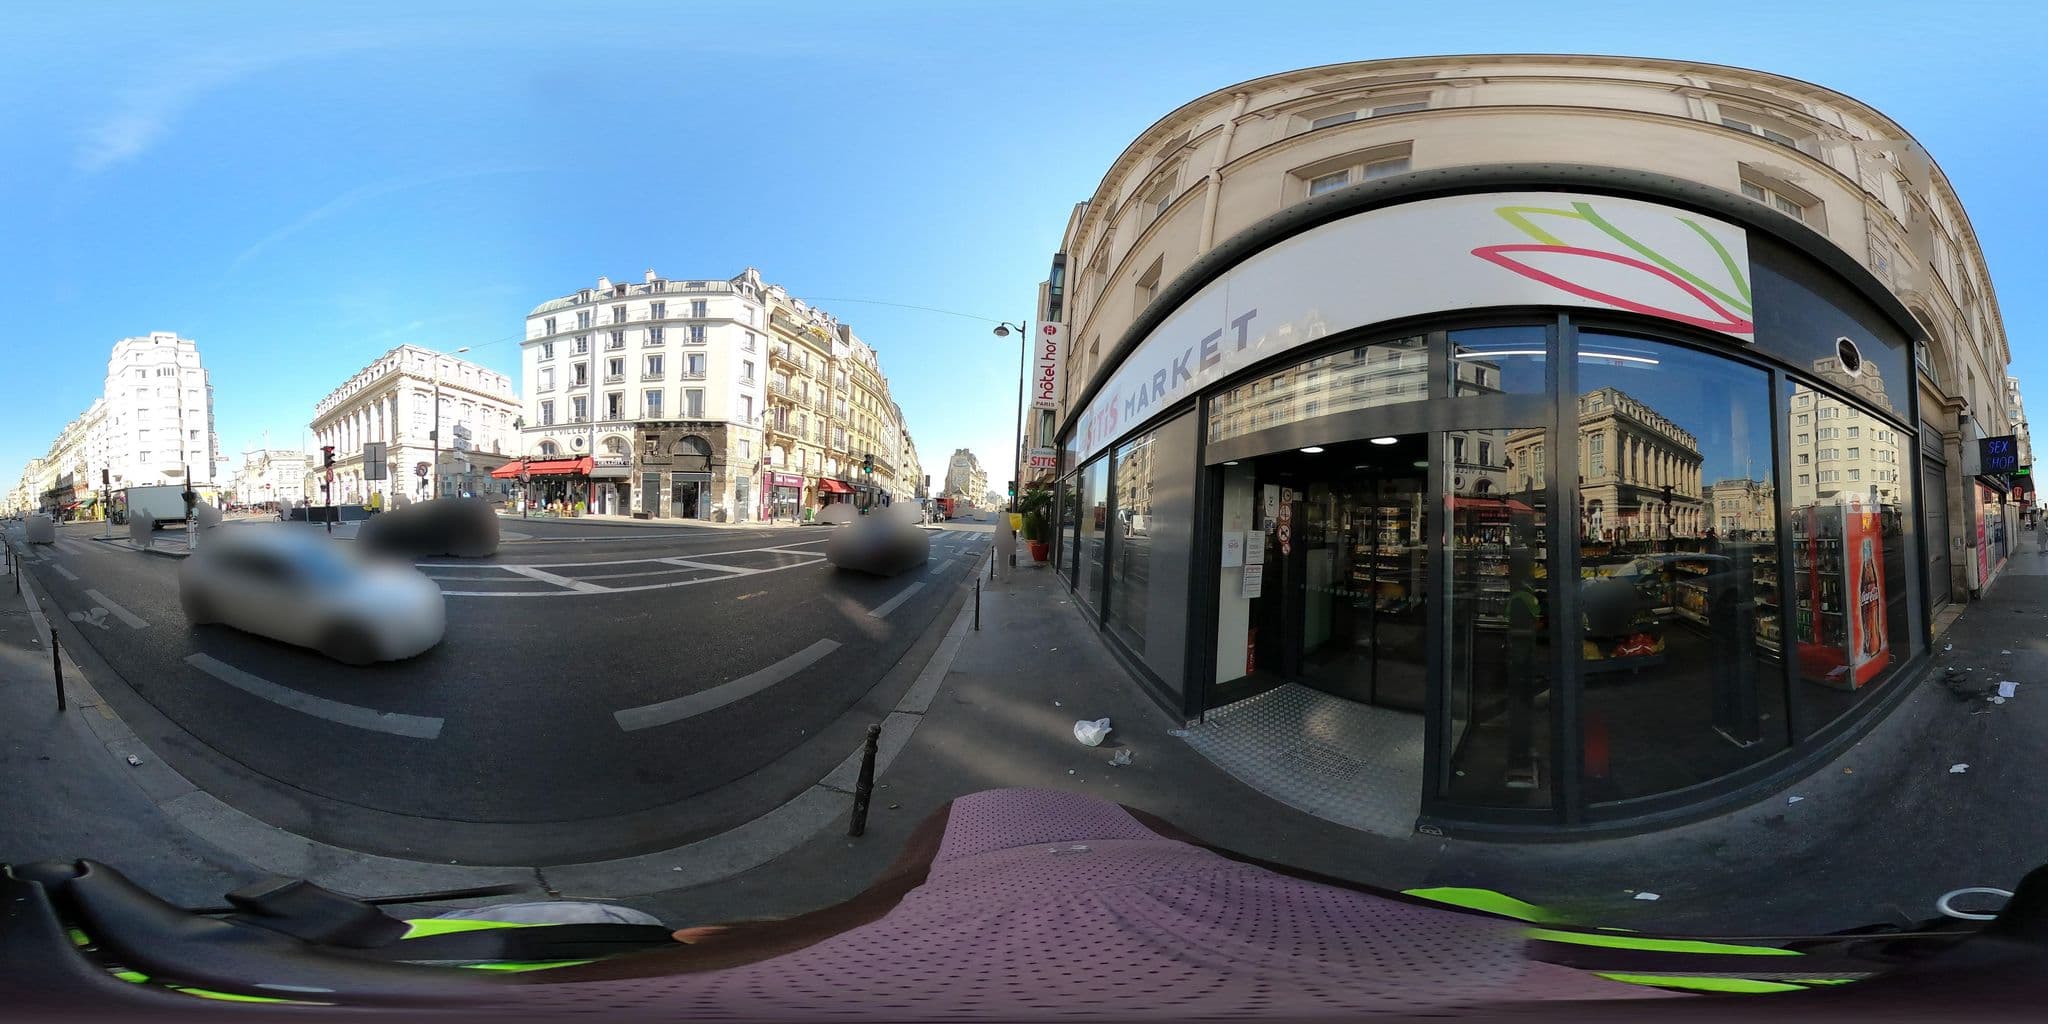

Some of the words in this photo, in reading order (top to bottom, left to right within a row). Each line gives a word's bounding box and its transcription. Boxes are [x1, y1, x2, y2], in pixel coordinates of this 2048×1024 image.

[1041, 339, 1057, 361] hor
[1124, 308, 1257, 423] MARKET
[1039, 364, 1056, 400] hôtel
[1988, 441, 2009, 454] SEX
[1031, 456, 1057, 467] SITIS
